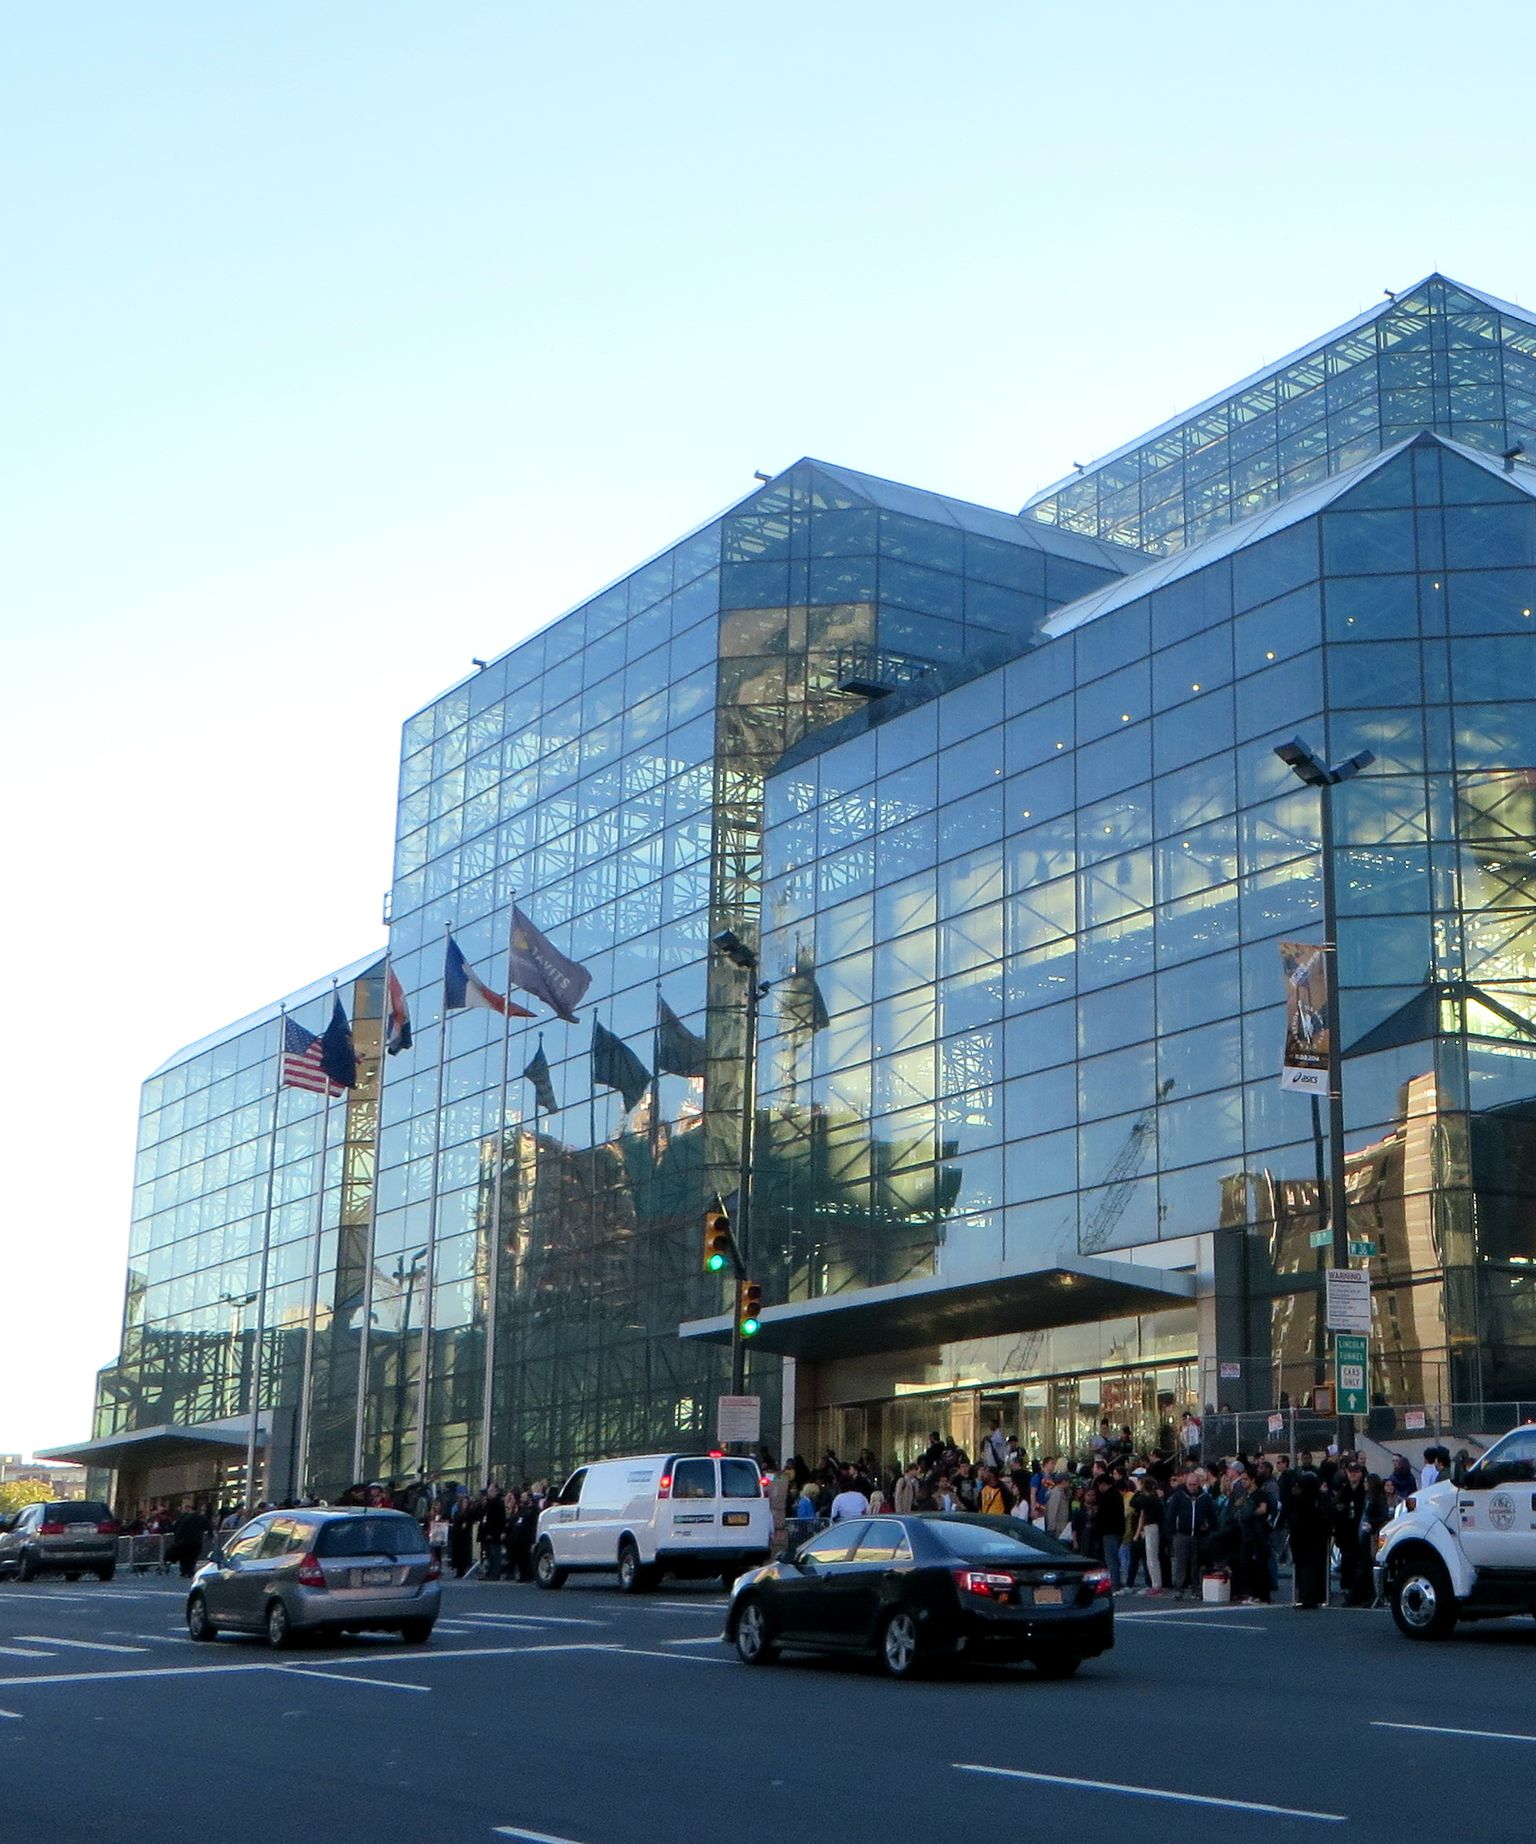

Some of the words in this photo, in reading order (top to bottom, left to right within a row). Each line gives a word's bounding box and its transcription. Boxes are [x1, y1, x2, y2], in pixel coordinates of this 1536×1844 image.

[532, 946, 570, 989] JAVITS
[1338, 1340, 1365, 1349] LINCOLN
[1339, 1351, 1364, 1361] TUNNEL
[1343, 1368, 1360, 1376] CARS
[1343, 1378, 1360, 1387] ONLY
